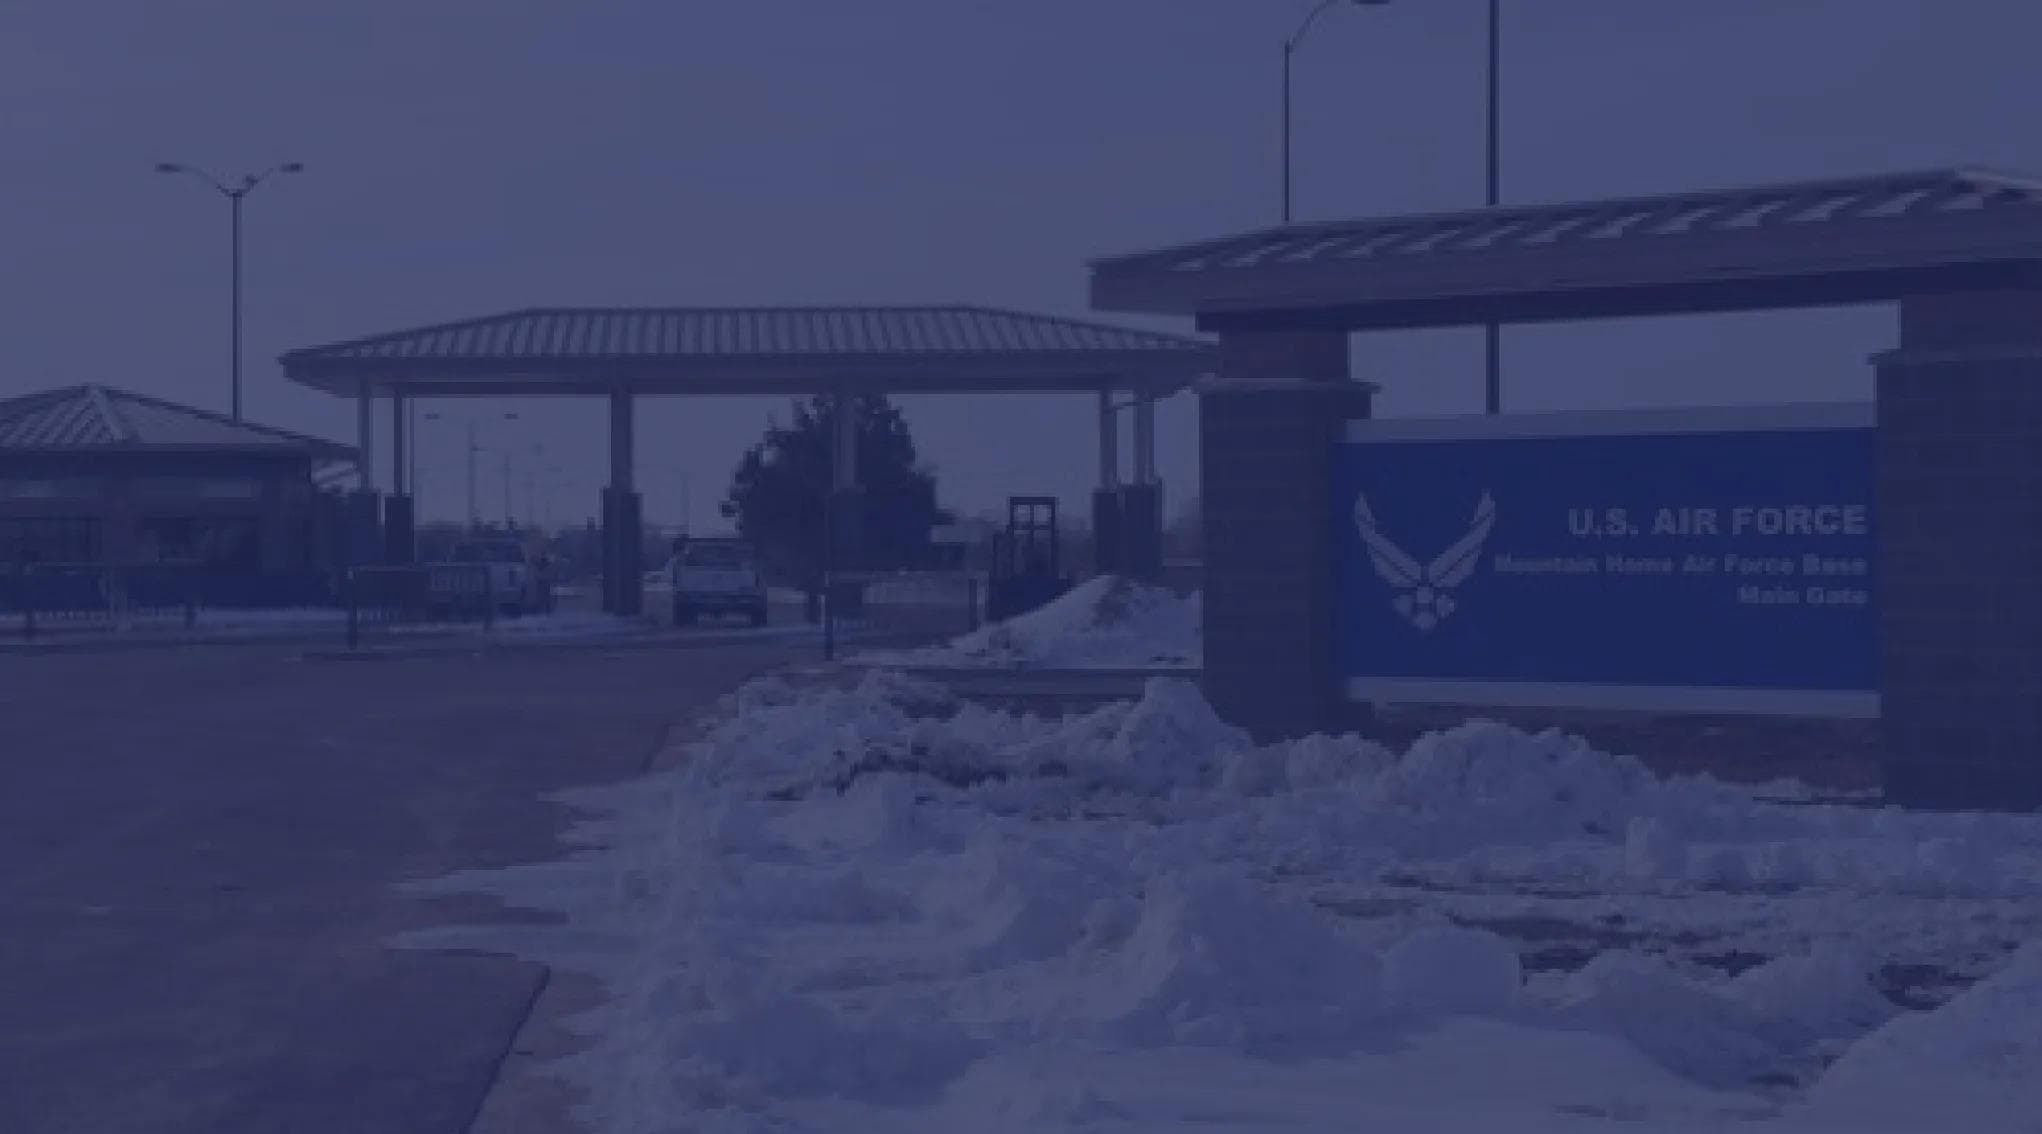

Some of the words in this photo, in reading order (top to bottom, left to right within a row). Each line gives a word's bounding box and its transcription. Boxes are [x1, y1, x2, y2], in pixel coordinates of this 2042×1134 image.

[1568, 506, 1639, 535] U.S.
[1651, 506, 1718, 535] AIR
[1732, 504, 1868, 535] FORCE
[1683, 554, 1717, 574] Air
[1724, 553, 1795, 575] Force
[1802, 553, 1868, 575] Base
[1737, 585, 1800, 605] Main
